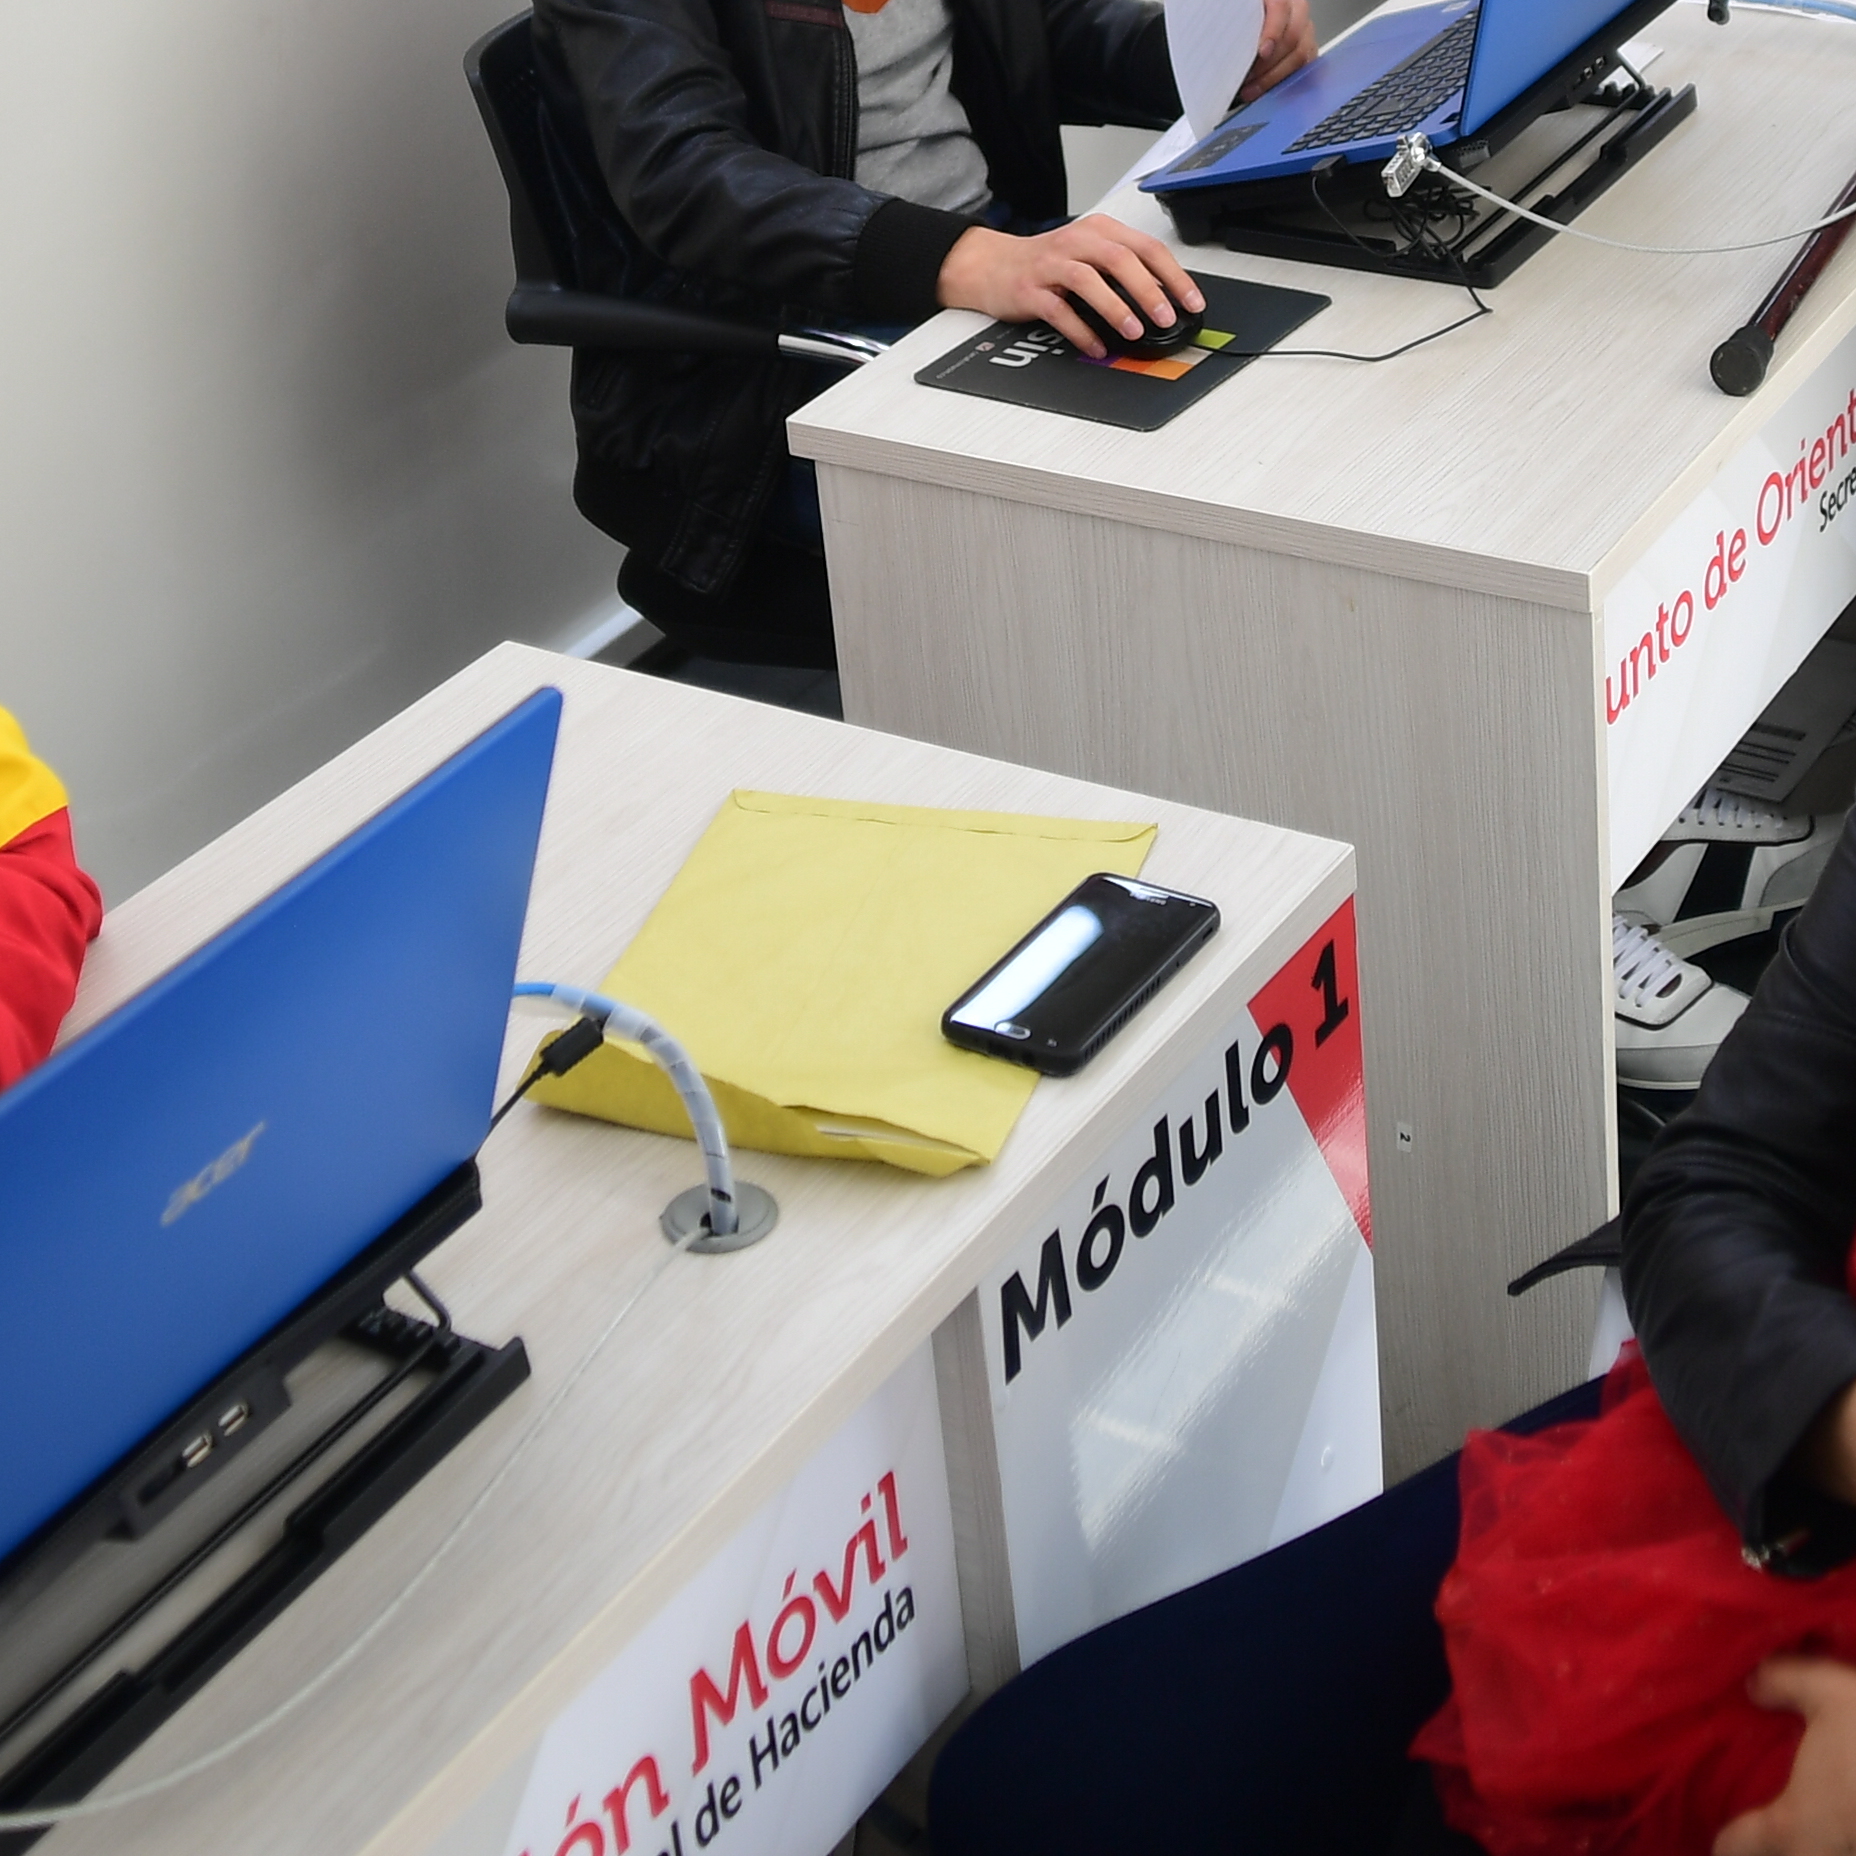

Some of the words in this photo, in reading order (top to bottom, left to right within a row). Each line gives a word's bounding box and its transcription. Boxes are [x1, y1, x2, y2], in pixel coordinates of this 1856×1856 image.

[1704, 528, 1746, 611] de
[1000, 1023, 1294, 1387] Módulo
[1312, 938, 1350, 1049] 1
[689, 1470, 909, 1777] Móvil
[695, 1774, 743, 1847] de
[748, 1584, 916, 1790] Hacienda
